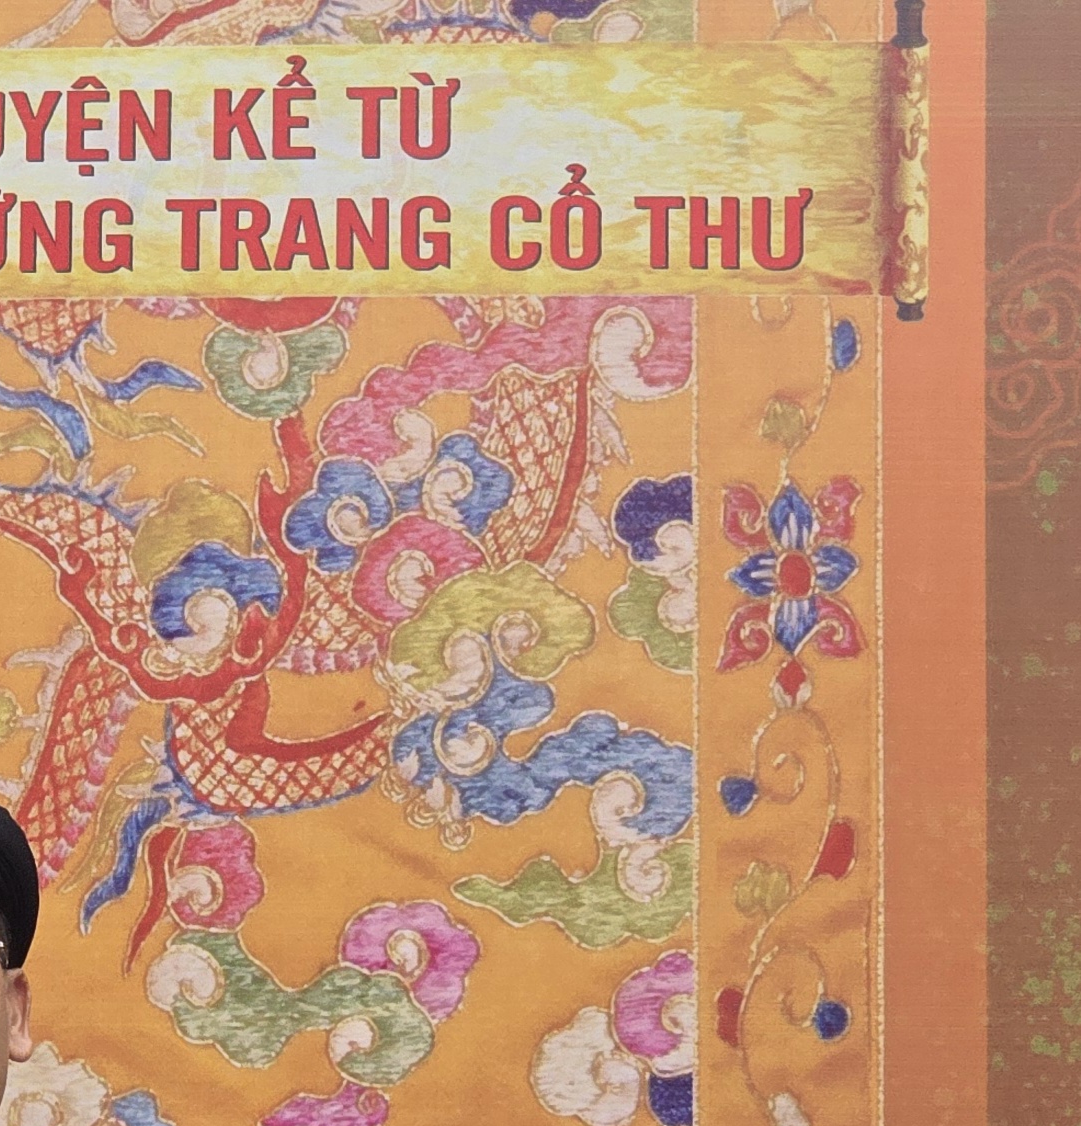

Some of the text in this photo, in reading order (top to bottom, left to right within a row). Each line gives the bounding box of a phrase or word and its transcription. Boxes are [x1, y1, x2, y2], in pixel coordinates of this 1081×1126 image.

[213, 55, 315, 160] KỂ
[346, 71, 459, 159] TỪ
[166, 195, 453, 272] TRANG
[490, 162, 603, 270] CỔ
[635, 187, 814, 271] THƯ
